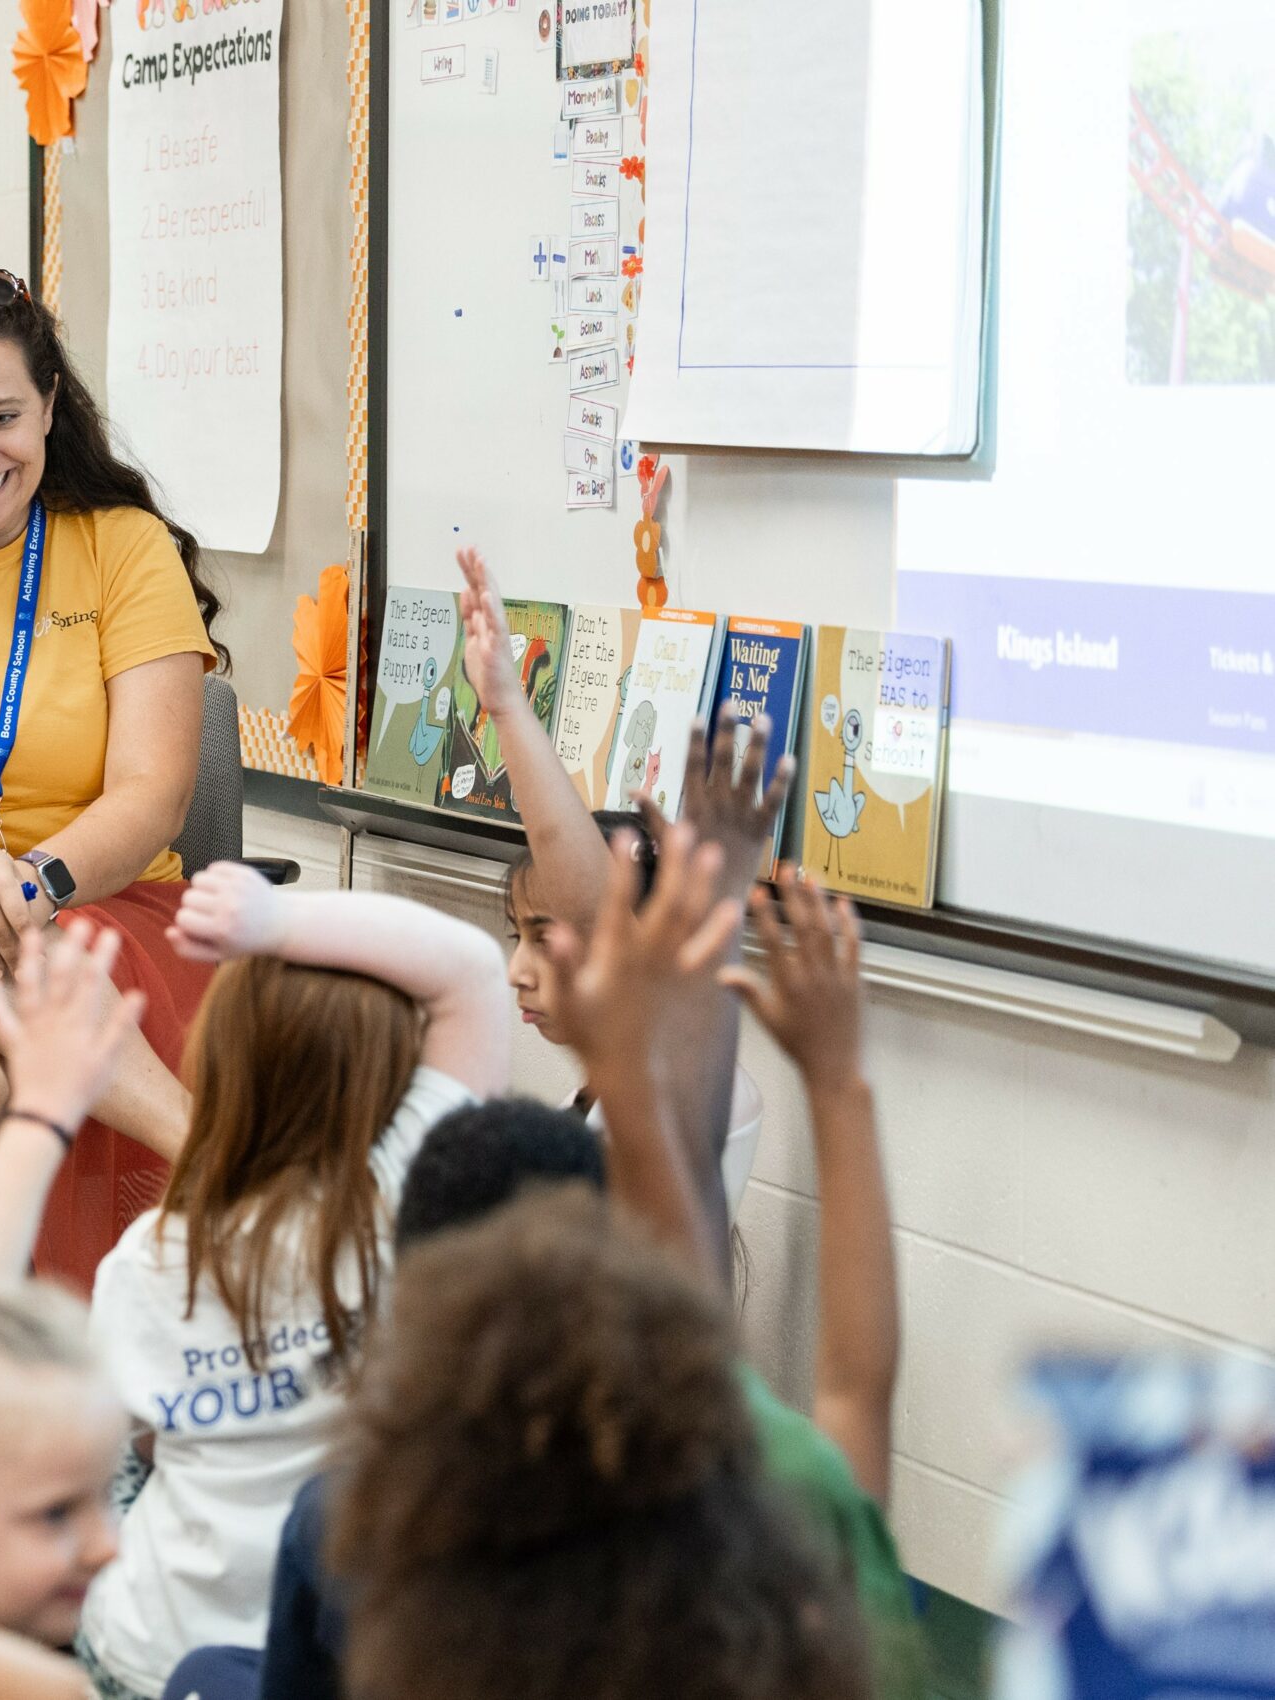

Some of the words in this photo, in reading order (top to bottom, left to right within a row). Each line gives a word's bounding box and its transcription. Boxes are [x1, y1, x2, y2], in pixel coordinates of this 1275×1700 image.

[565, 5, 590, 25] DOING
[592, 0, 627, 22] TODAY?
[122, 53, 168, 92] Camp
[173, 26, 272, 86] Expectations
[568, 88, 597, 107] Morning
[159, 134, 181, 171] Be
[184, 124, 218, 167] safe
[585, 130, 608, 148] Reading
[157, 202, 178, 239] Be
[183, 187, 266, 246] respectful
[584, 250, 601, 267] Math
[157, 271, 176, 309] Be
[181, 265, 217, 307] kind
[585, 287, 603, 303] Lunch
[157, 343, 179, 378] Do
[183, 348, 221, 390] your
[226, 336, 259, 376] best
[584, 448, 599, 470] Gym
[29, 499, 43, 550] Excellenc
[22, 552, 38, 602] Achieving
[390, 600, 408, 620] The
[410, 600, 451, 627] Pigeon
[576, 613, 609, 636] Don't
[13, 630, 27, 666] Schools
[387, 628, 417, 651] Wants
[421, 635, 430, 652] a
[572, 639, 591, 660] Let
[595, 641, 615, 662] the
[653, 634, 676, 661] Can
[681, 637, 690, 662] I
[997, 623, 1054, 671] Kings
[1055, 629, 1118, 671] Island
[730, 637, 781, 675] Waiting
[848, 649, 874, 672] The
[878, 649, 931, 680] Pigeon
[1209, 645, 1260, 675] Tickets
[6, 667, 21, 703] County
[383, 657, 422, 686] Puppy!
[569, 664, 609, 689] Pigeon
[634, 663, 663, 695] Play
[667, 666, 698, 693] Too?
[730, 665, 744, 690] Is
[746, 668, 771, 694] Not
[566, 689, 599, 712] Drive
[730, 691, 767, 720] Easy!
[879, 684, 907, 709] HAS
[912, 688, 929, 711] to
[0, 705, 14, 739] Boone
[563, 716, 581, 735] the
[911, 720, 926, 739] to
[558, 740, 582, 762] Bus!
[864, 740, 925, 769] School!
[183, 1320, 331, 1377] Prode
[156, 1366, 305, 1431] YOUR
